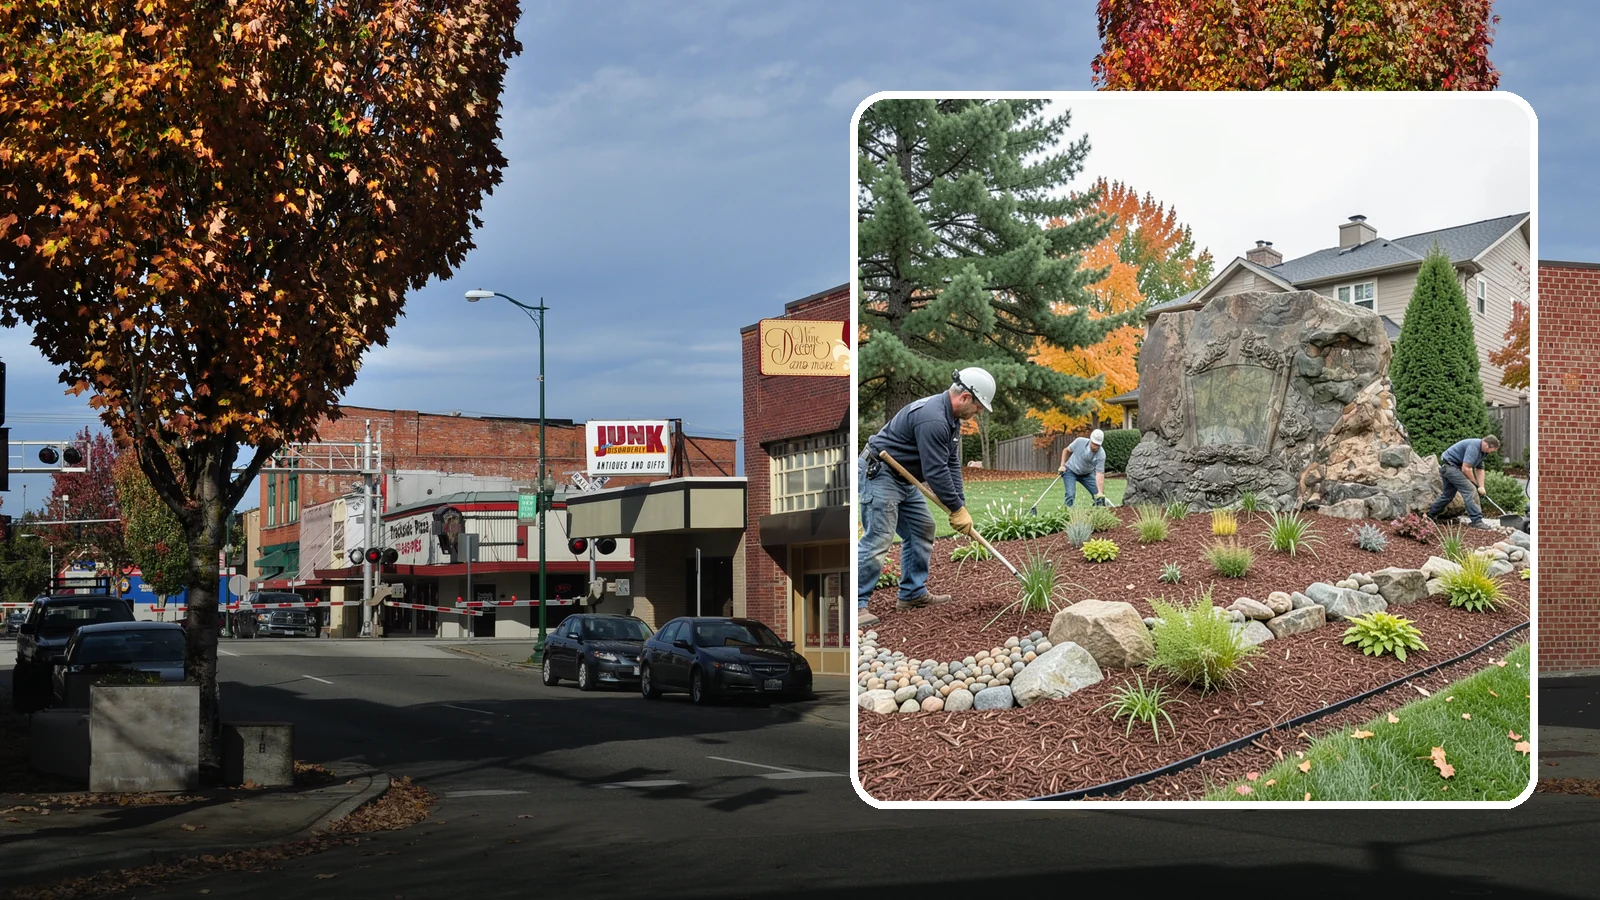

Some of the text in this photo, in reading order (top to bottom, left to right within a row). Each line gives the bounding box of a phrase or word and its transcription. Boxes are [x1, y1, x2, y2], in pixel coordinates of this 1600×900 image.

[765, 327, 830, 365] Decor
[596, 425, 664, 457] JUNK
[607, 446, 646, 454] DISORDERLY
[597, 460, 665, 470] ANTIQUES AND GIFTS
[414, 519, 429, 534] Pizza
